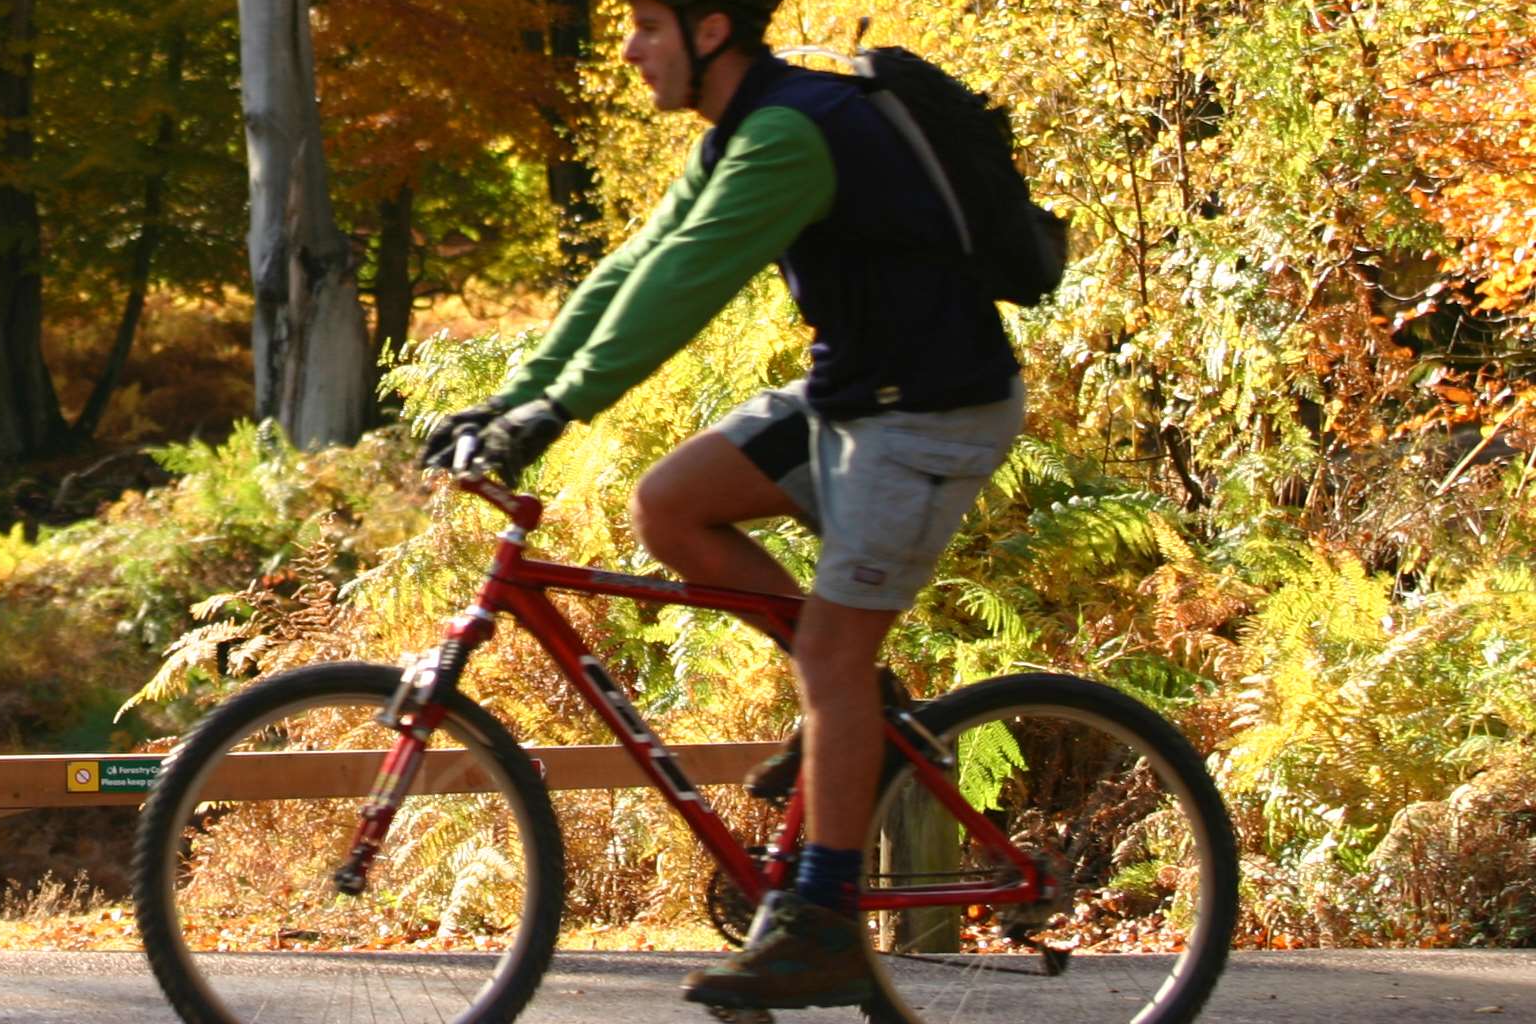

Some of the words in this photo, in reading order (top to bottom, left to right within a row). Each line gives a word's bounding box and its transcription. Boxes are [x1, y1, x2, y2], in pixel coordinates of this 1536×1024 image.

[119, 766, 149, 775] Forestry
[101, 778, 125, 786] Please
[127, 777, 146, 787] keep
